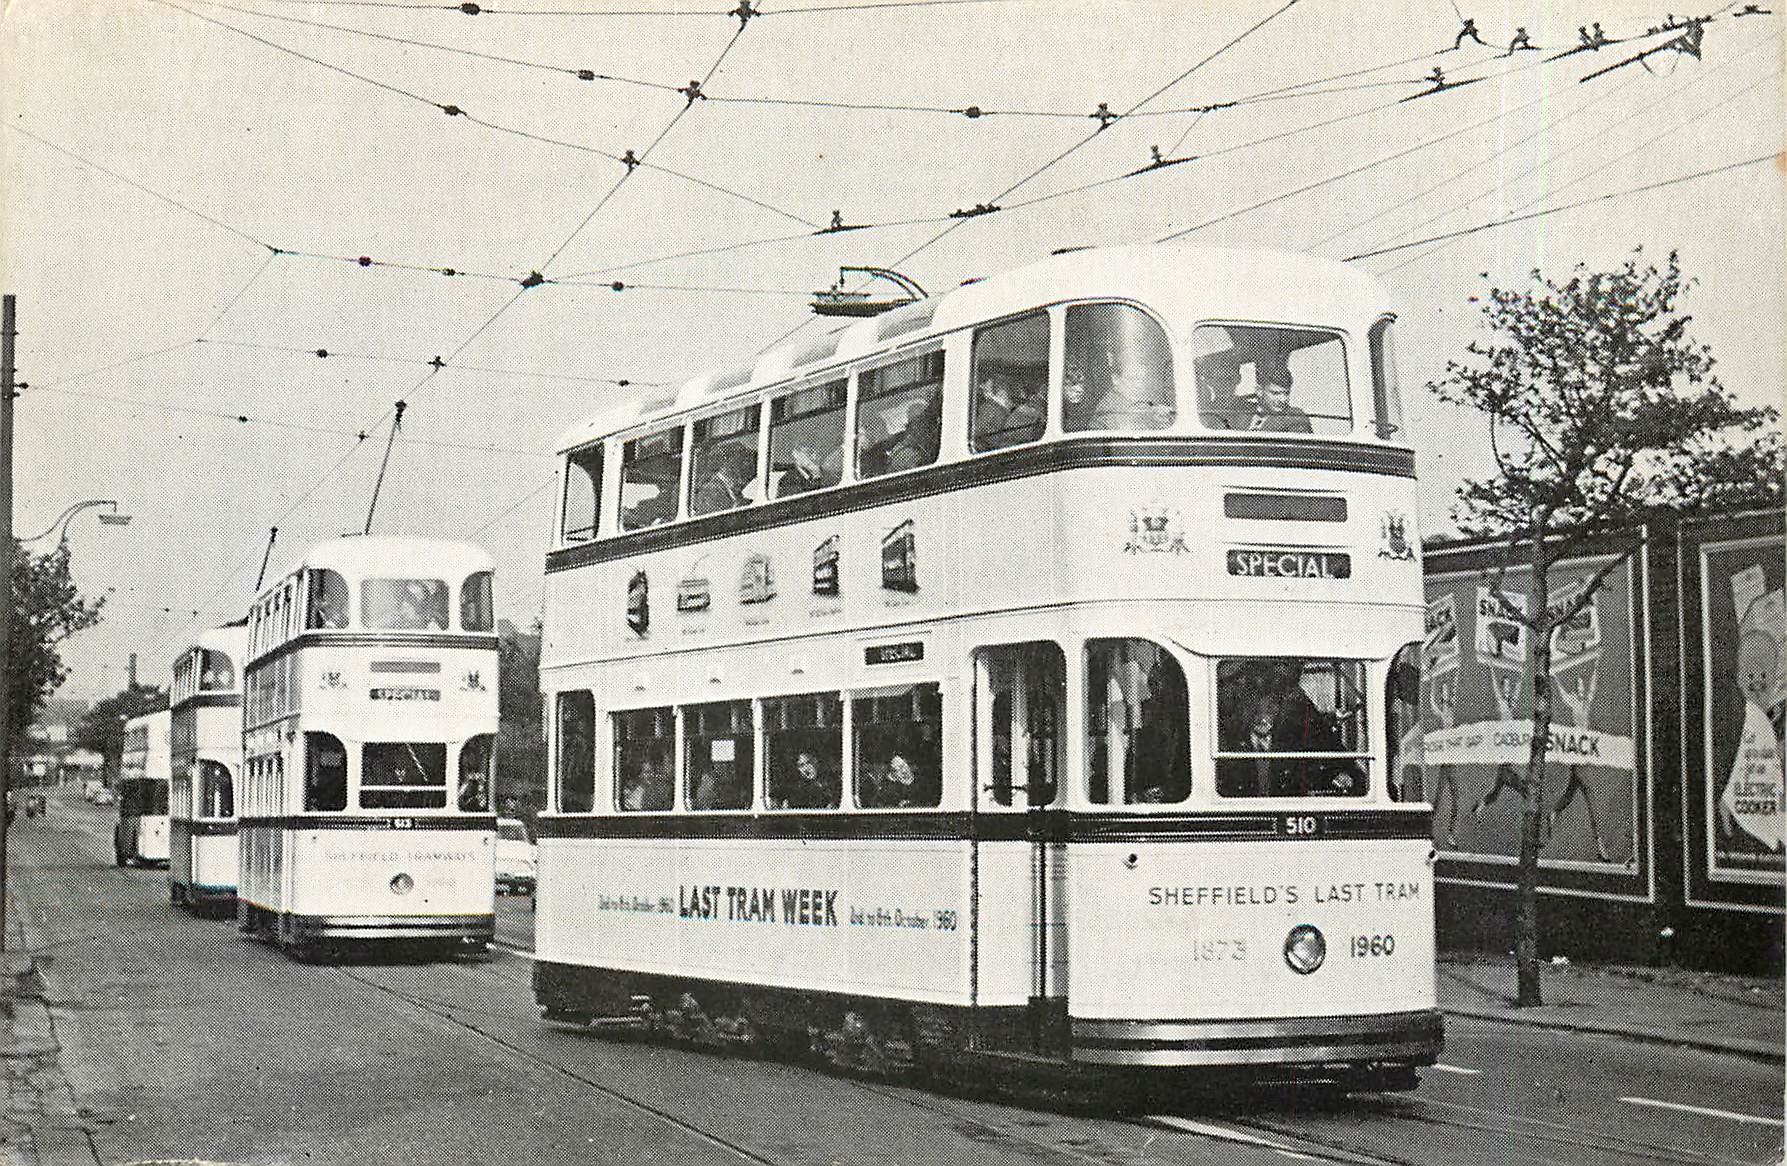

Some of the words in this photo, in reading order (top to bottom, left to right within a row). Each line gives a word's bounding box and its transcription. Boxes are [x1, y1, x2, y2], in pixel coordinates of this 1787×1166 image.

[1236, 553, 1334, 578] SPECIAL
[1545, 732, 1600, 758] SNACK
[1735, 799, 1777, 816] COOKER
[1286, 816, 1317, 834] 510
[678, 884, 721, 920] LAST
[727, 886, 776, 923] TRAM
[781, 888, 838, 927] WEEK
[1149, 884, 1299, 905] SHEFFIELD'S
[1315, 883, 1366, 903] LAST
[1375, 882, 1420, 901] TRAM
[1350, 934, 1395, 958] 1960
